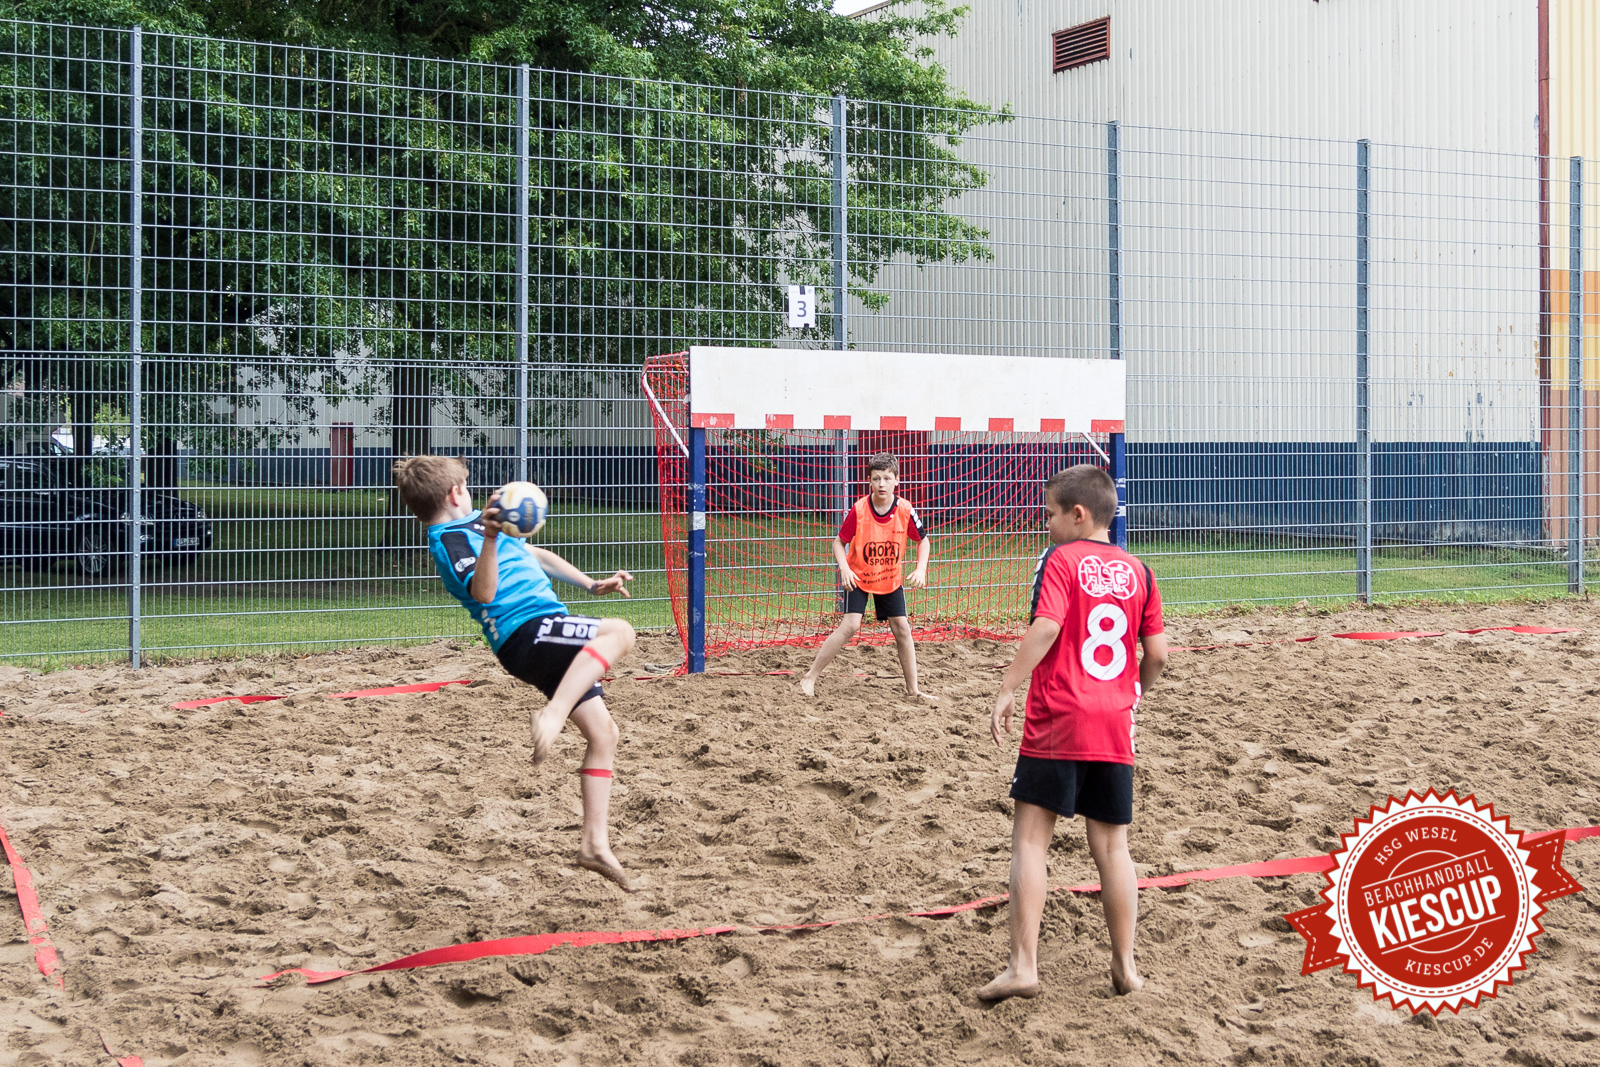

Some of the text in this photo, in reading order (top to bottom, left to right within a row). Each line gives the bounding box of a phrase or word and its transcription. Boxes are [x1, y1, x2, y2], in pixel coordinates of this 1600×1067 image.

[797, 300, 807, 318] 3
[869, 558, 895, 566] SPORT
[1085, 564, 1130, 588] HSG
[1081, 603, 1128, 681] 8
